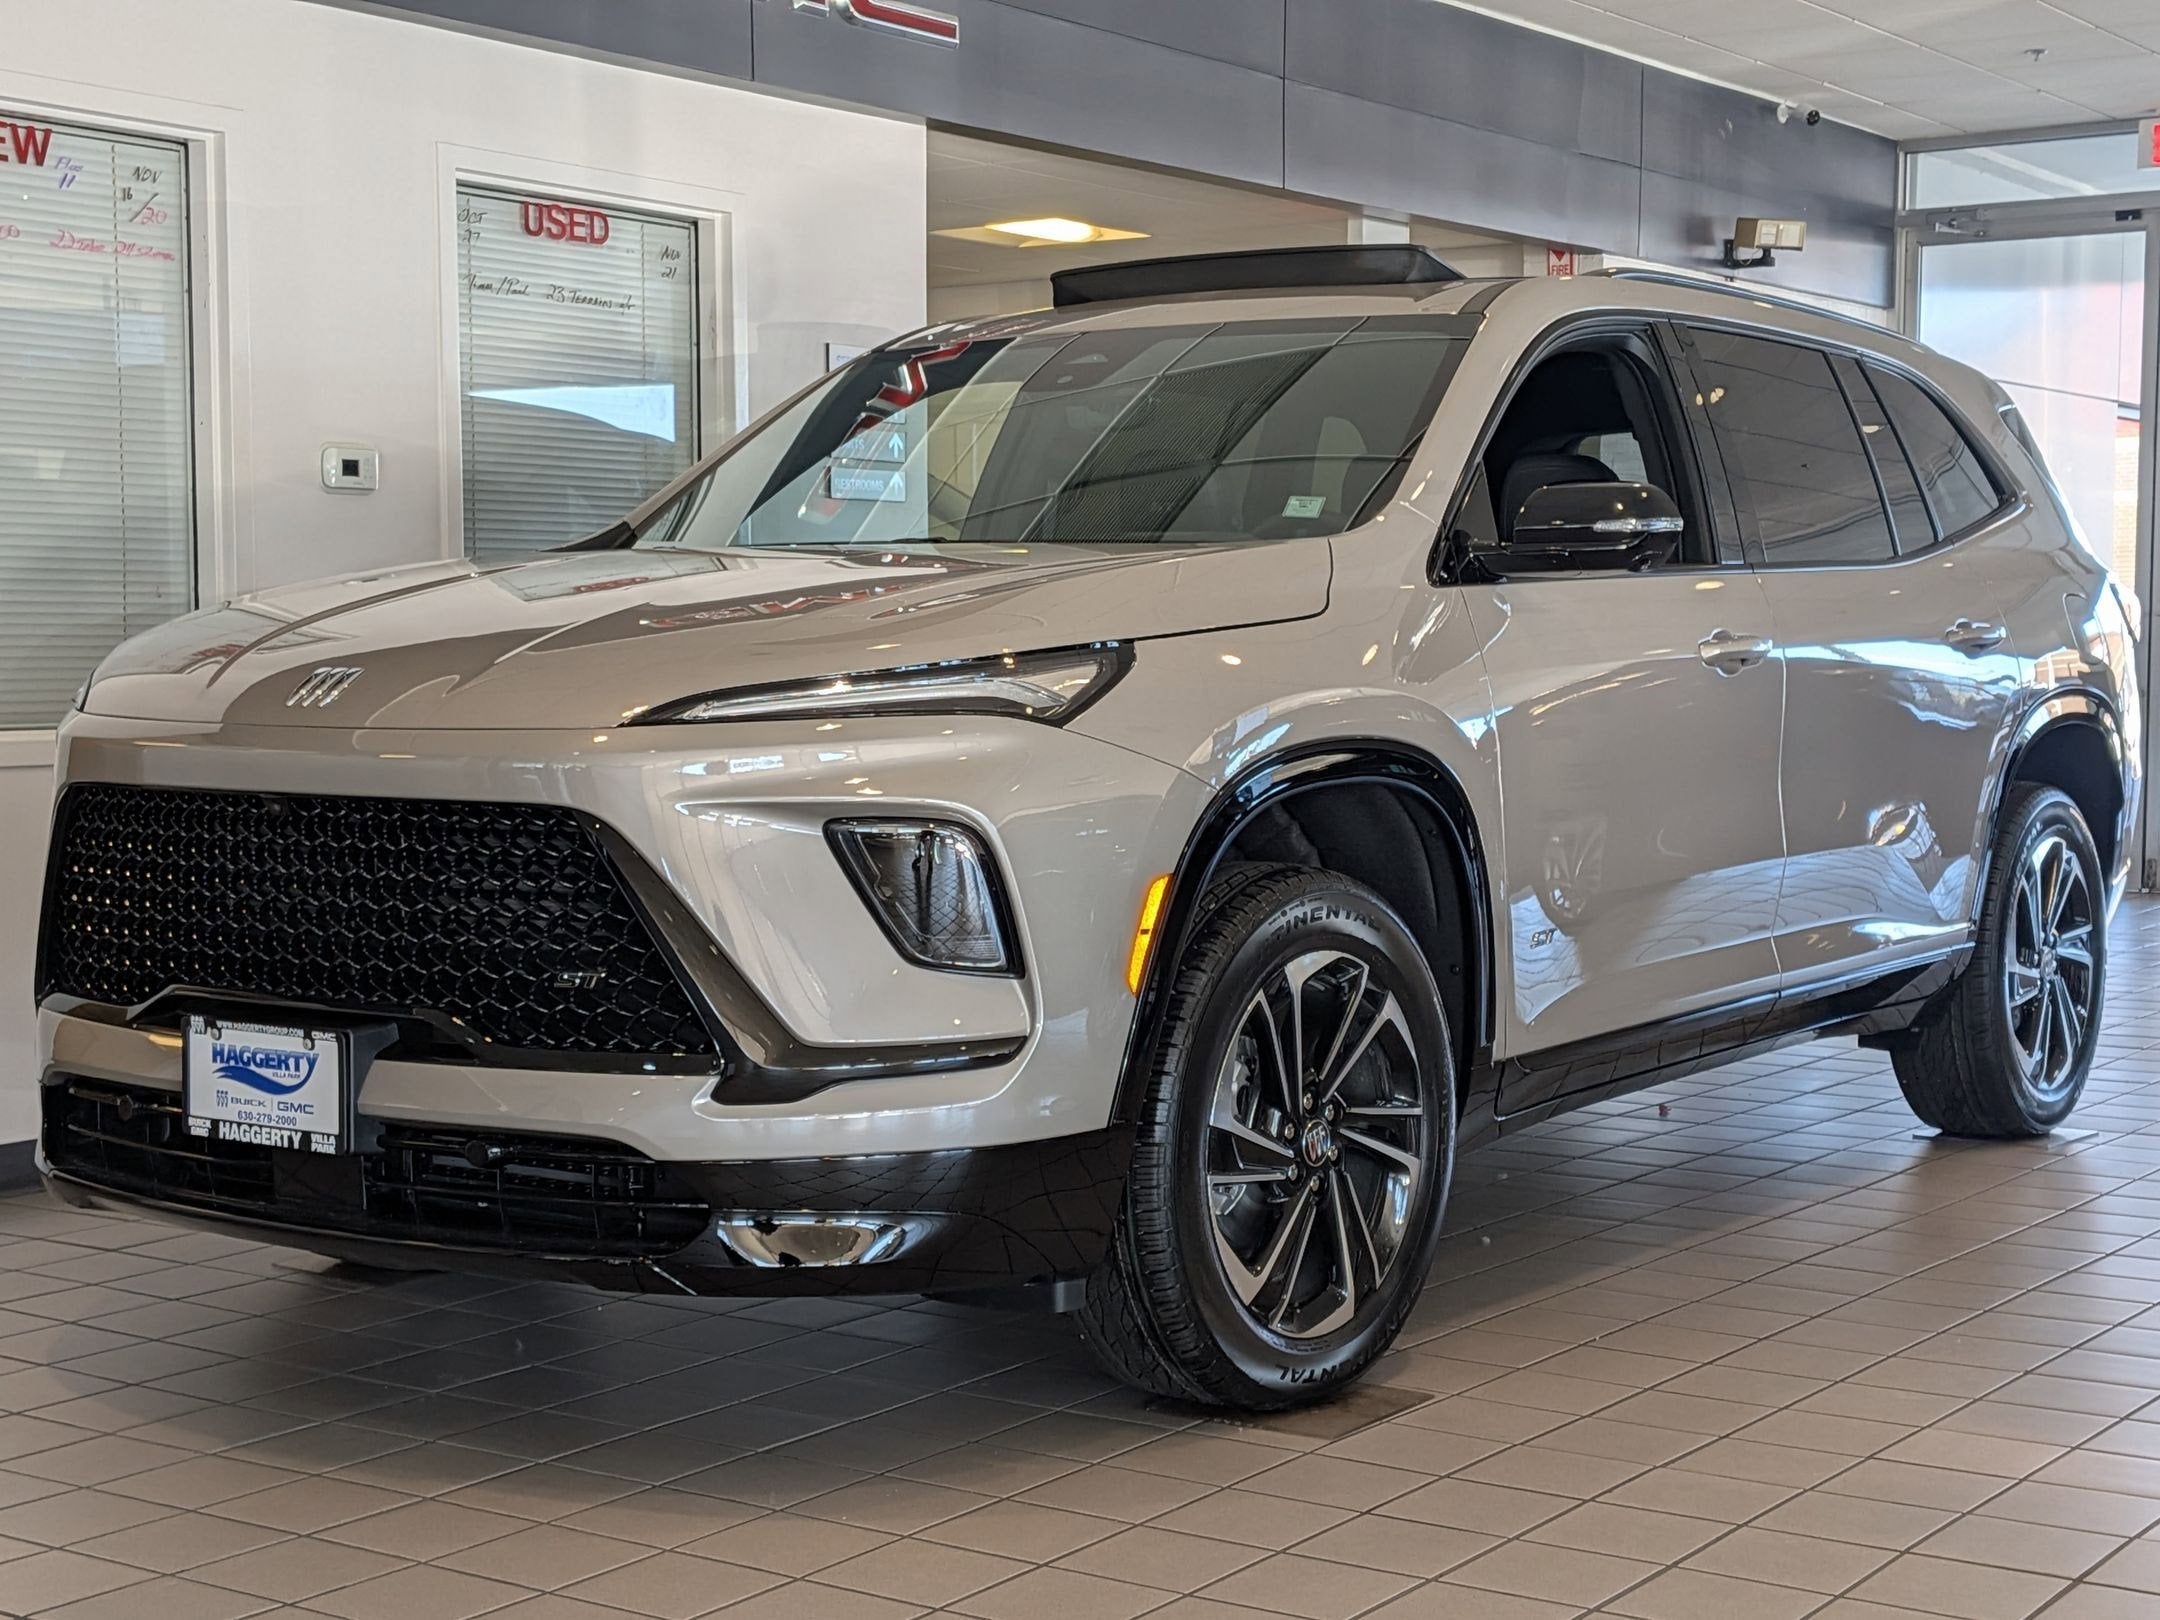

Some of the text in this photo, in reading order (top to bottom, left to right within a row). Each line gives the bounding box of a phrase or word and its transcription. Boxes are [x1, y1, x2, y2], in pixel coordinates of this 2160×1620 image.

[521, 201, 610, 245] USED
[1551, 264, 1570, 276] FIRE
[311, 1031, 337, 1042] GMC
[212, 1042, 320, 1073] HAGGERTY
[231, 1096, 315, 1115] BUICK GMC
[237, 1109, 297, 1127] 630-279-2000
[218, 1120, 303, 1150] HAGGERTY
[310, 1132, 336, 1145] VILLA
[310, 1142, 336, 1155] PARK
